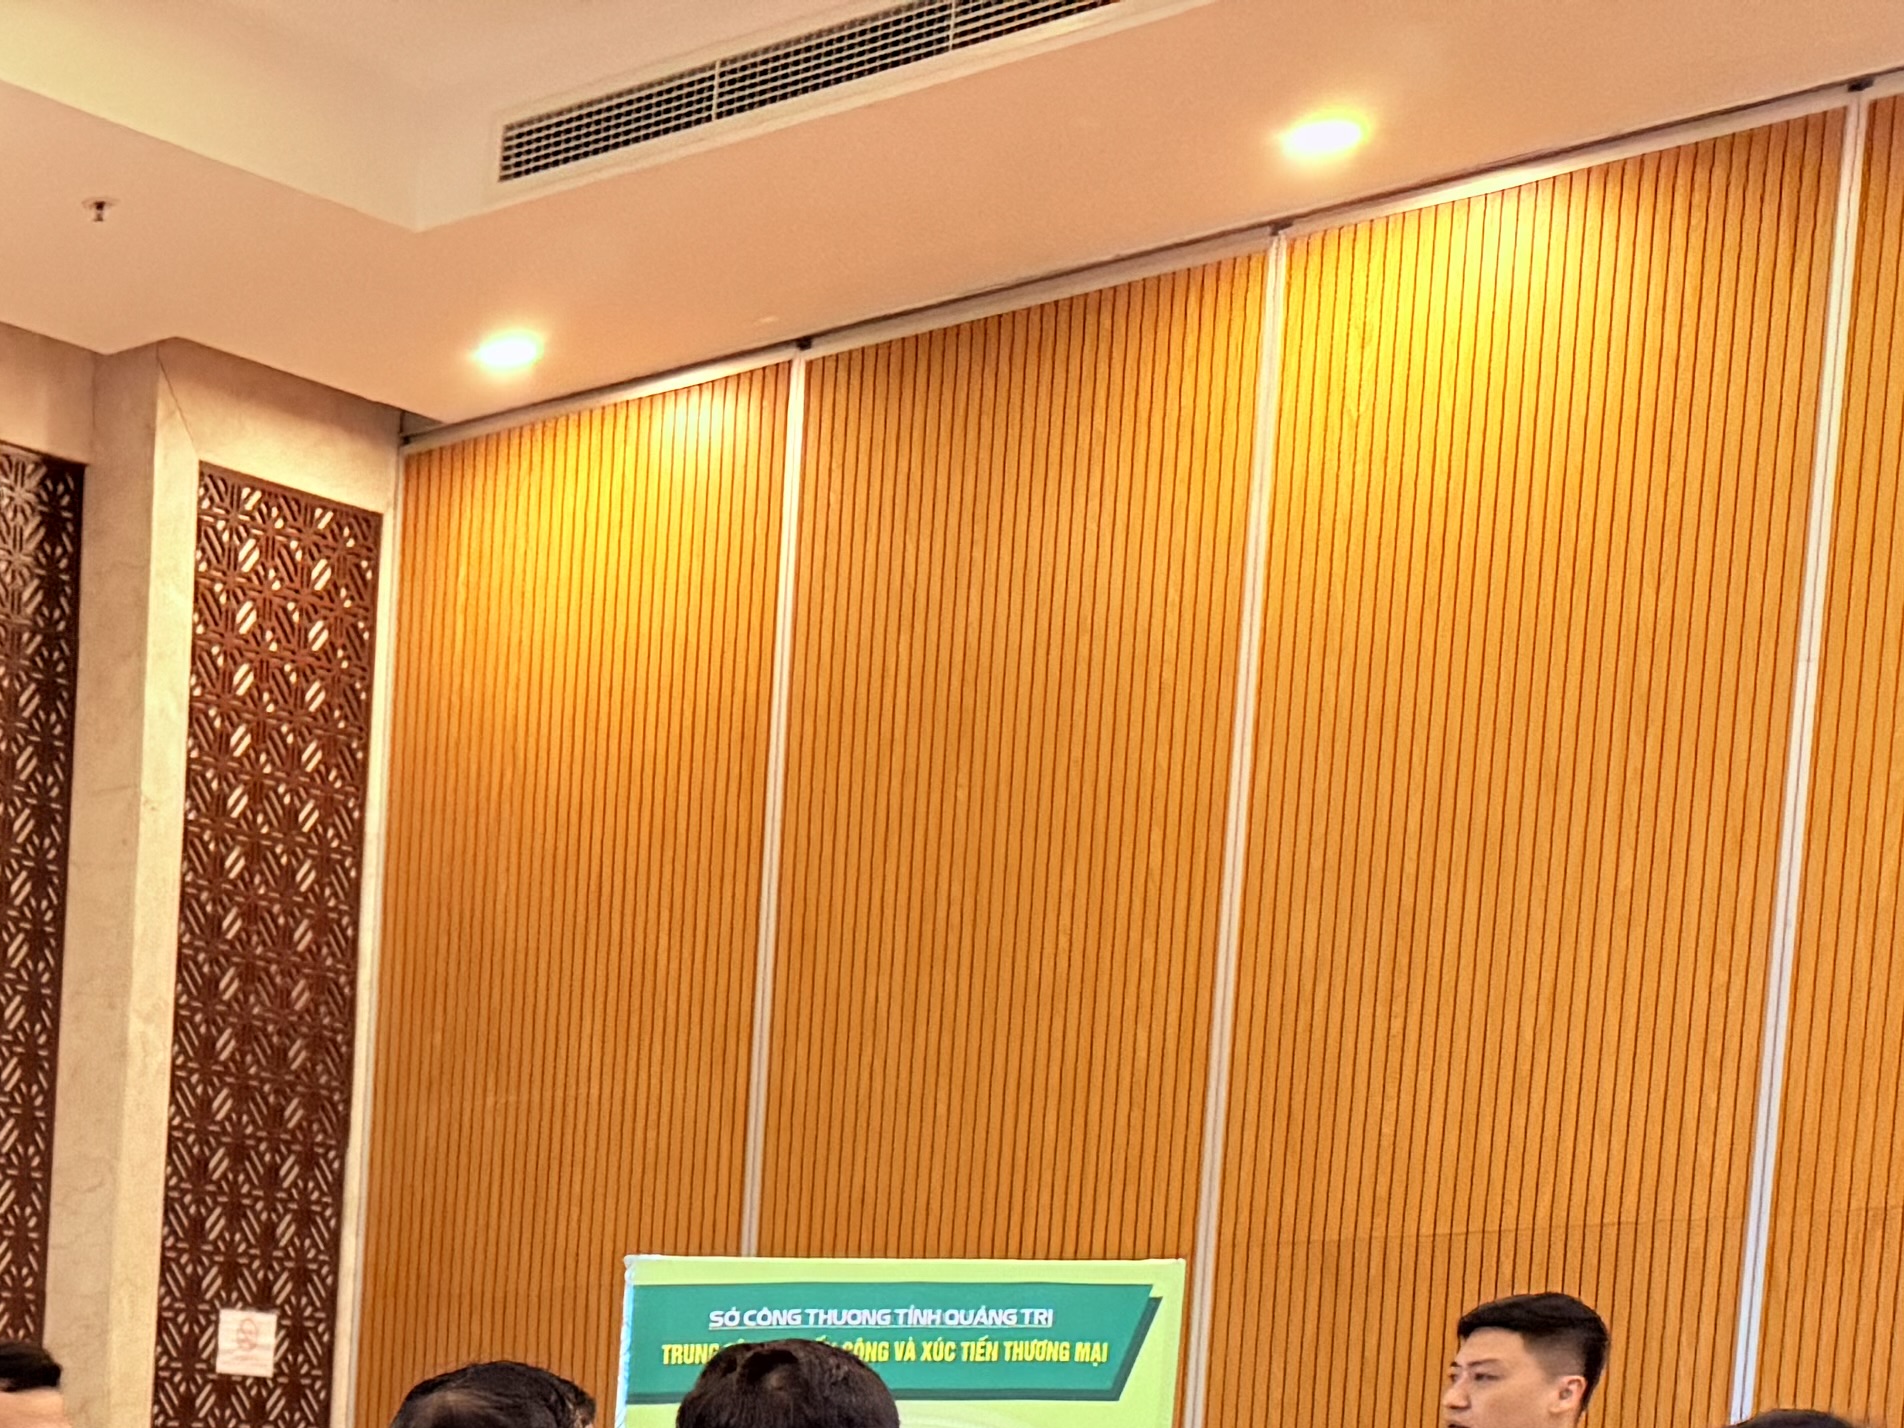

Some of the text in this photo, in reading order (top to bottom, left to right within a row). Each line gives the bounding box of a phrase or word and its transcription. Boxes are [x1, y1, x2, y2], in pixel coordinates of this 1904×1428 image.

[743, 1307, 802, 1326] CÔNG
[920, 1337, 955, 1361] XÚC
[961, 1335, 998, 1361] TIẾN
[1075, 1342, 1108, 1366] MẠI
